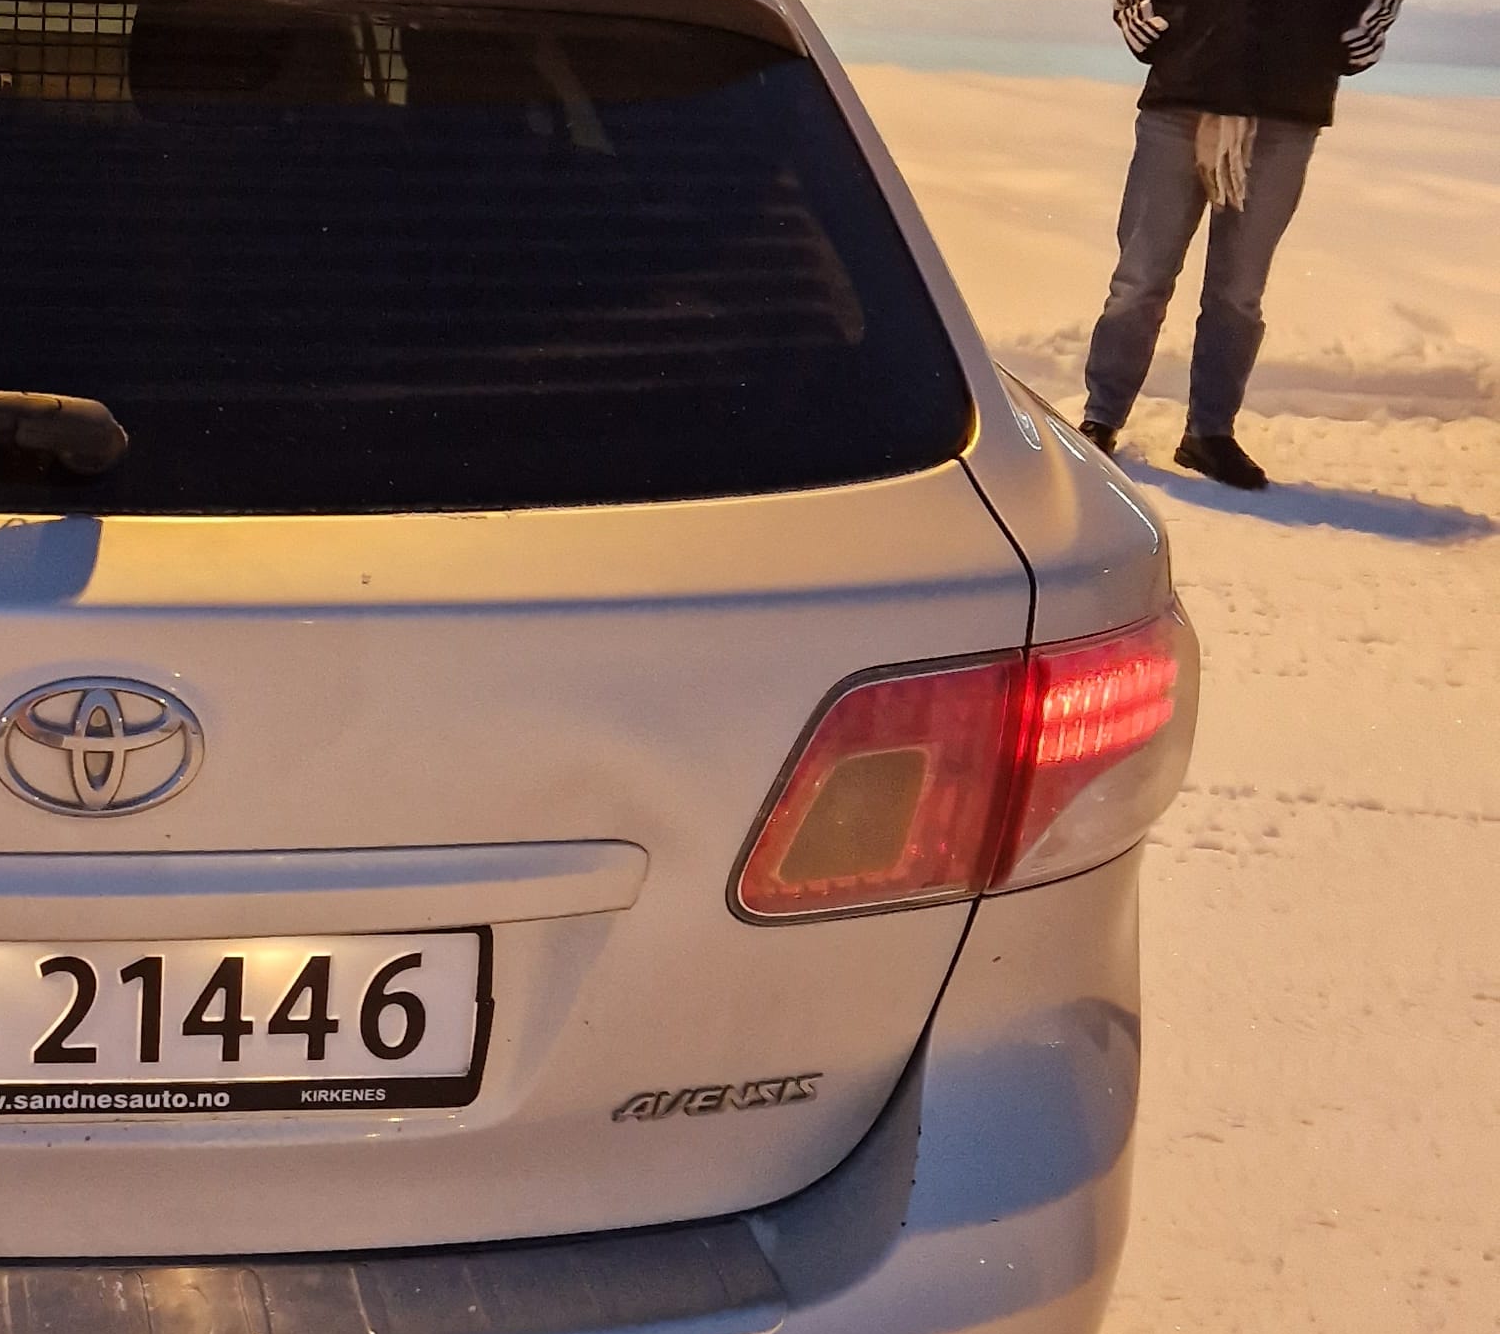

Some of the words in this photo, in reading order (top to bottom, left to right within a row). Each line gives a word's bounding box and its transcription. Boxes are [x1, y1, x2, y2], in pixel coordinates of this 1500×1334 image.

[32, 952, 429, 1065] 21446
[301, 1088, 386, 1103] KIRKENES
[611, 1072, 824, 1122] AVENSIS
